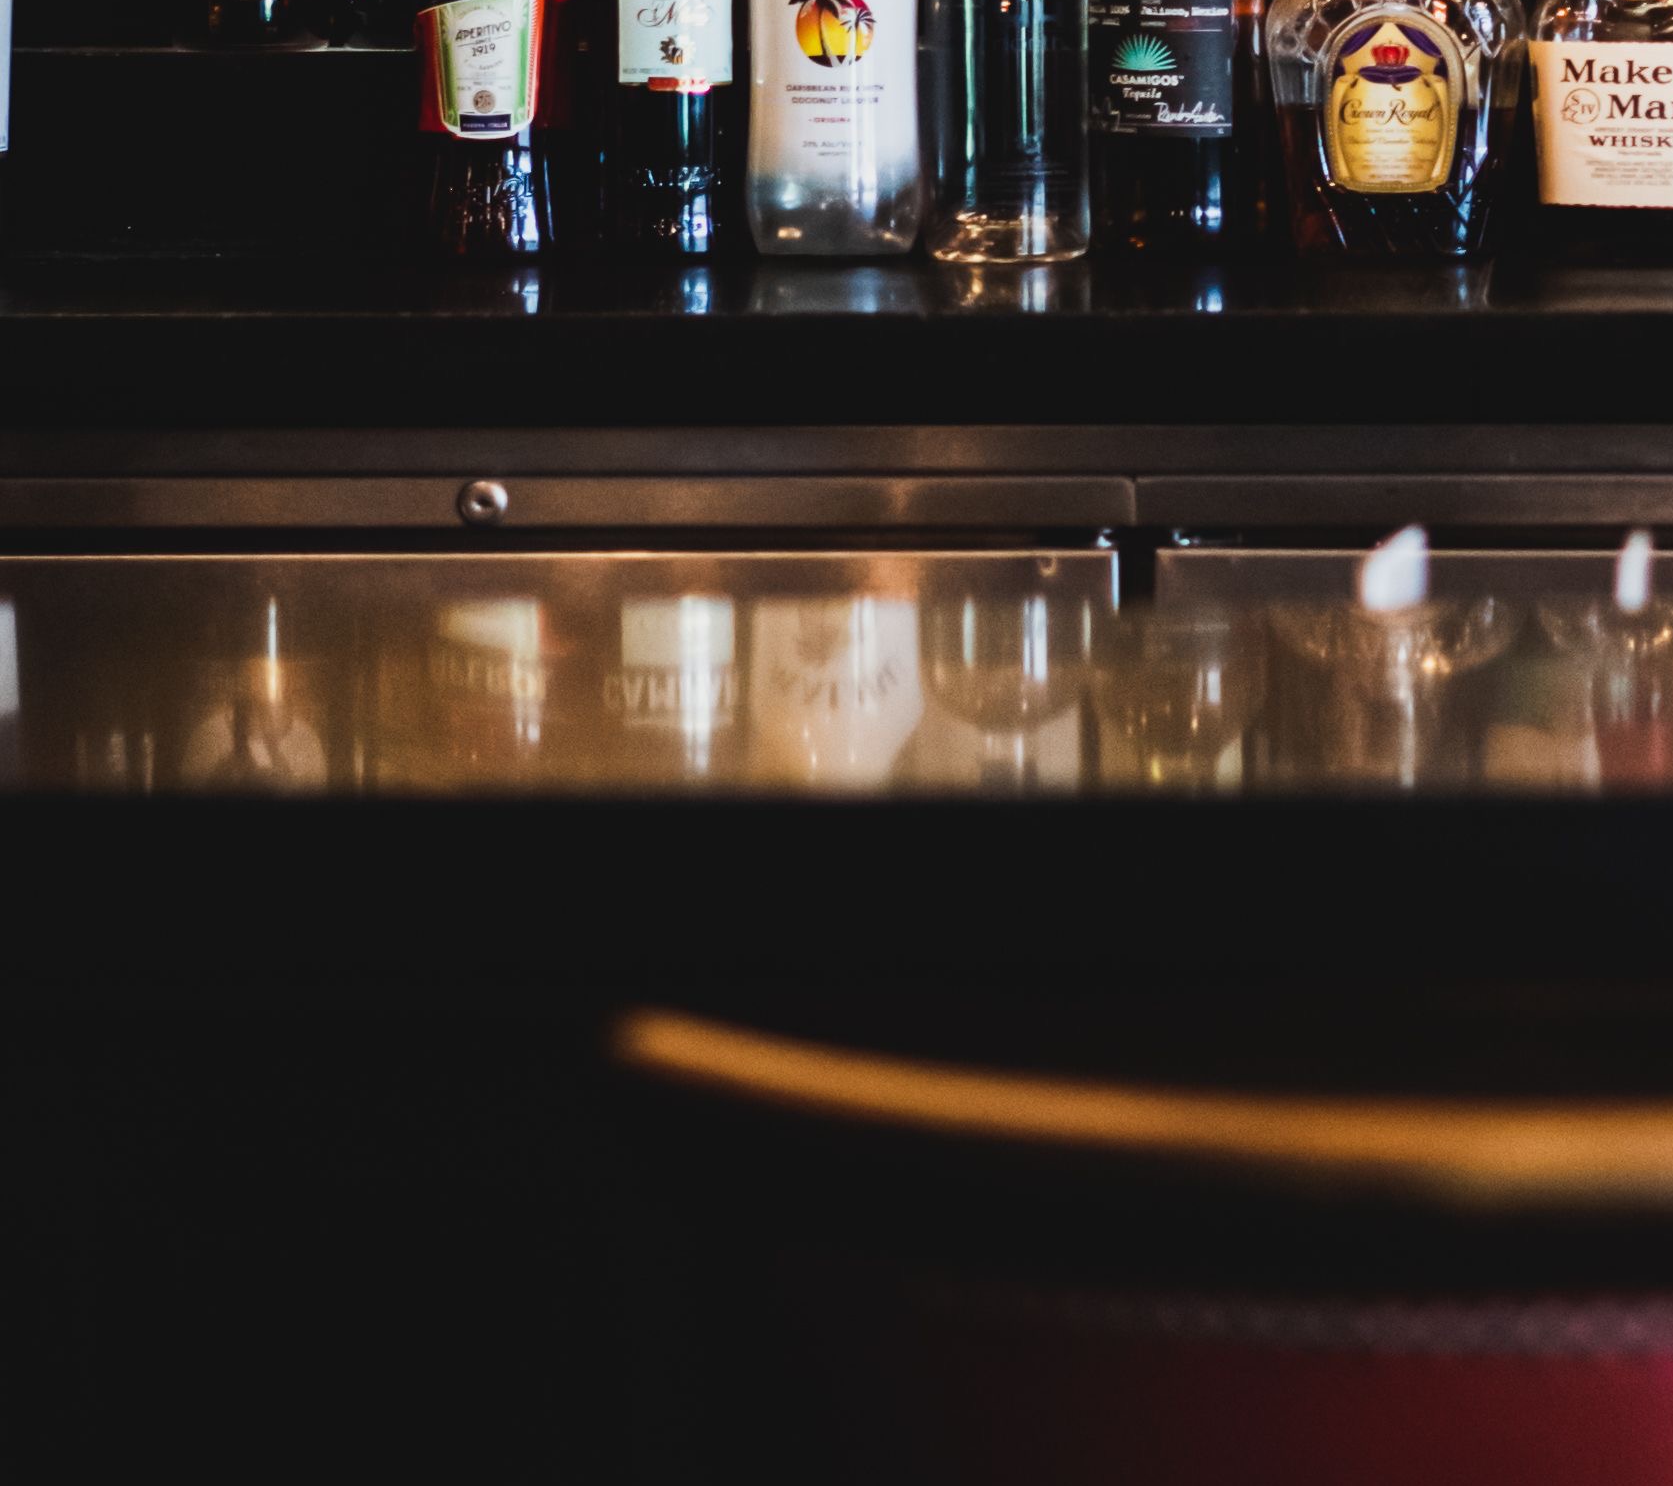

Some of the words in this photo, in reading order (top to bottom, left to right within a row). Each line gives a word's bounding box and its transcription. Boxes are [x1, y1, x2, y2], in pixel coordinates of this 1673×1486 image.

[454, 19, 513, 43] APERITIVO
[471, 42, 497, 58] 1919
[1108, 74, 1181, 87] CASAMIGOS
[1122, 86, 1163, 102] Tequila
[813, 116, 851, 124] ORIGINA
[1338, 98, 1386, 126] Crown
[1376, 98, 1441, 126] Royal
